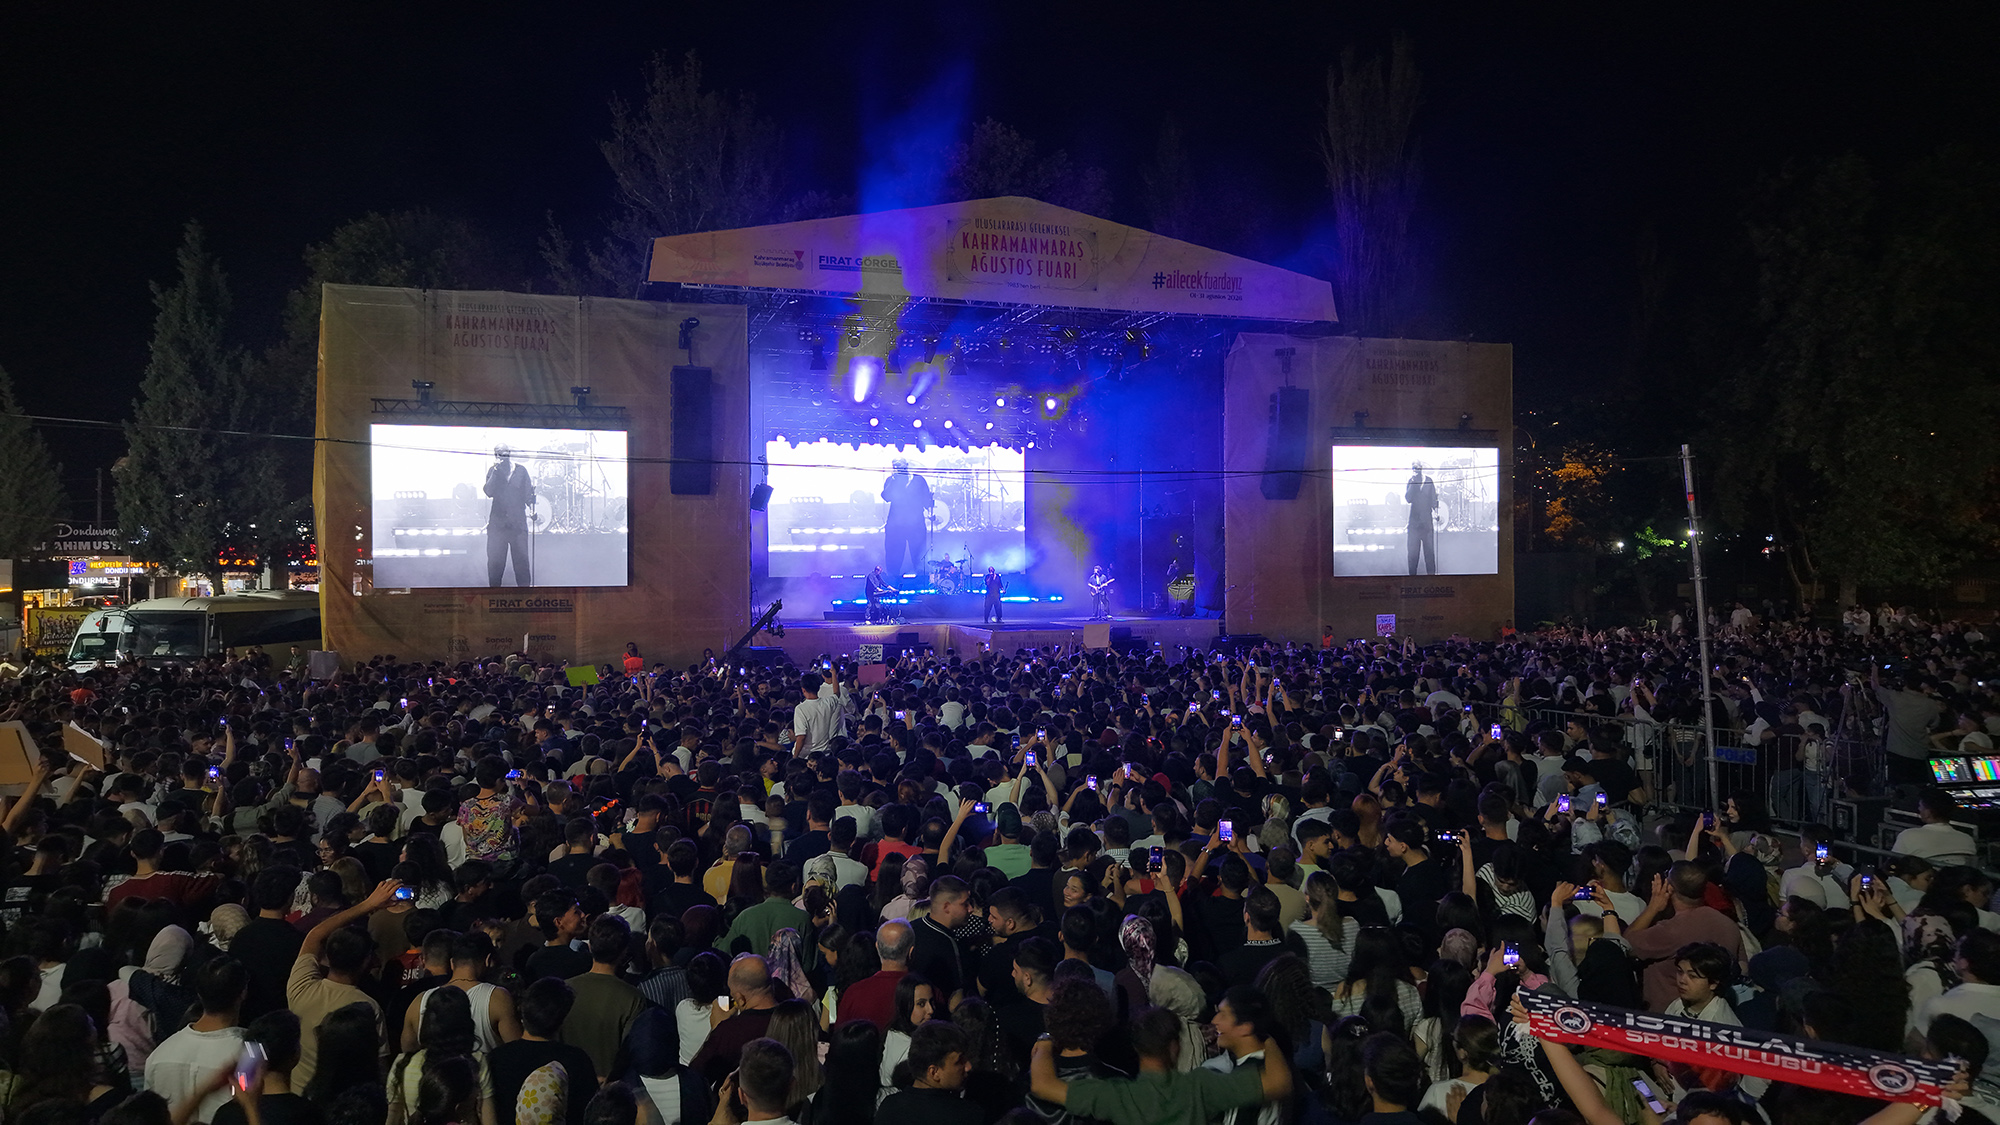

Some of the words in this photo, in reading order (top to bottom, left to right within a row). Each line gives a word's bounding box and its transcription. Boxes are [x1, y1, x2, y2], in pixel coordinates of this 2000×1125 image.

[974, 218, 1027, 233] ULUSLARARASI
[1029, 222, 1071, 237] GELENEKSEL
[962, 231, 1084, 261] KAHRAMANMARAŞ
[818, 255, 852, 266] FIRAT
[854, 256, 902, 270] GÖRGEL
[970, 252, 1033, 276] AĞUSTOS
[1037, 259, 1077, 280] FUARI
[453, 331, 510, 349] AĞUSTOS
[513, 335, 549, 352] FUARI
[68, 577, 108, 585] ONDURMA
[489, 599, 522, 608] FIRAT
[525, 597, 573, 608] GÖRGEL
[528, 634, 557, 642] ayata
[1625, 1029, 1699, 1053] SPOR
[1705, 1042, 1822, 1074] KULUBÜ
